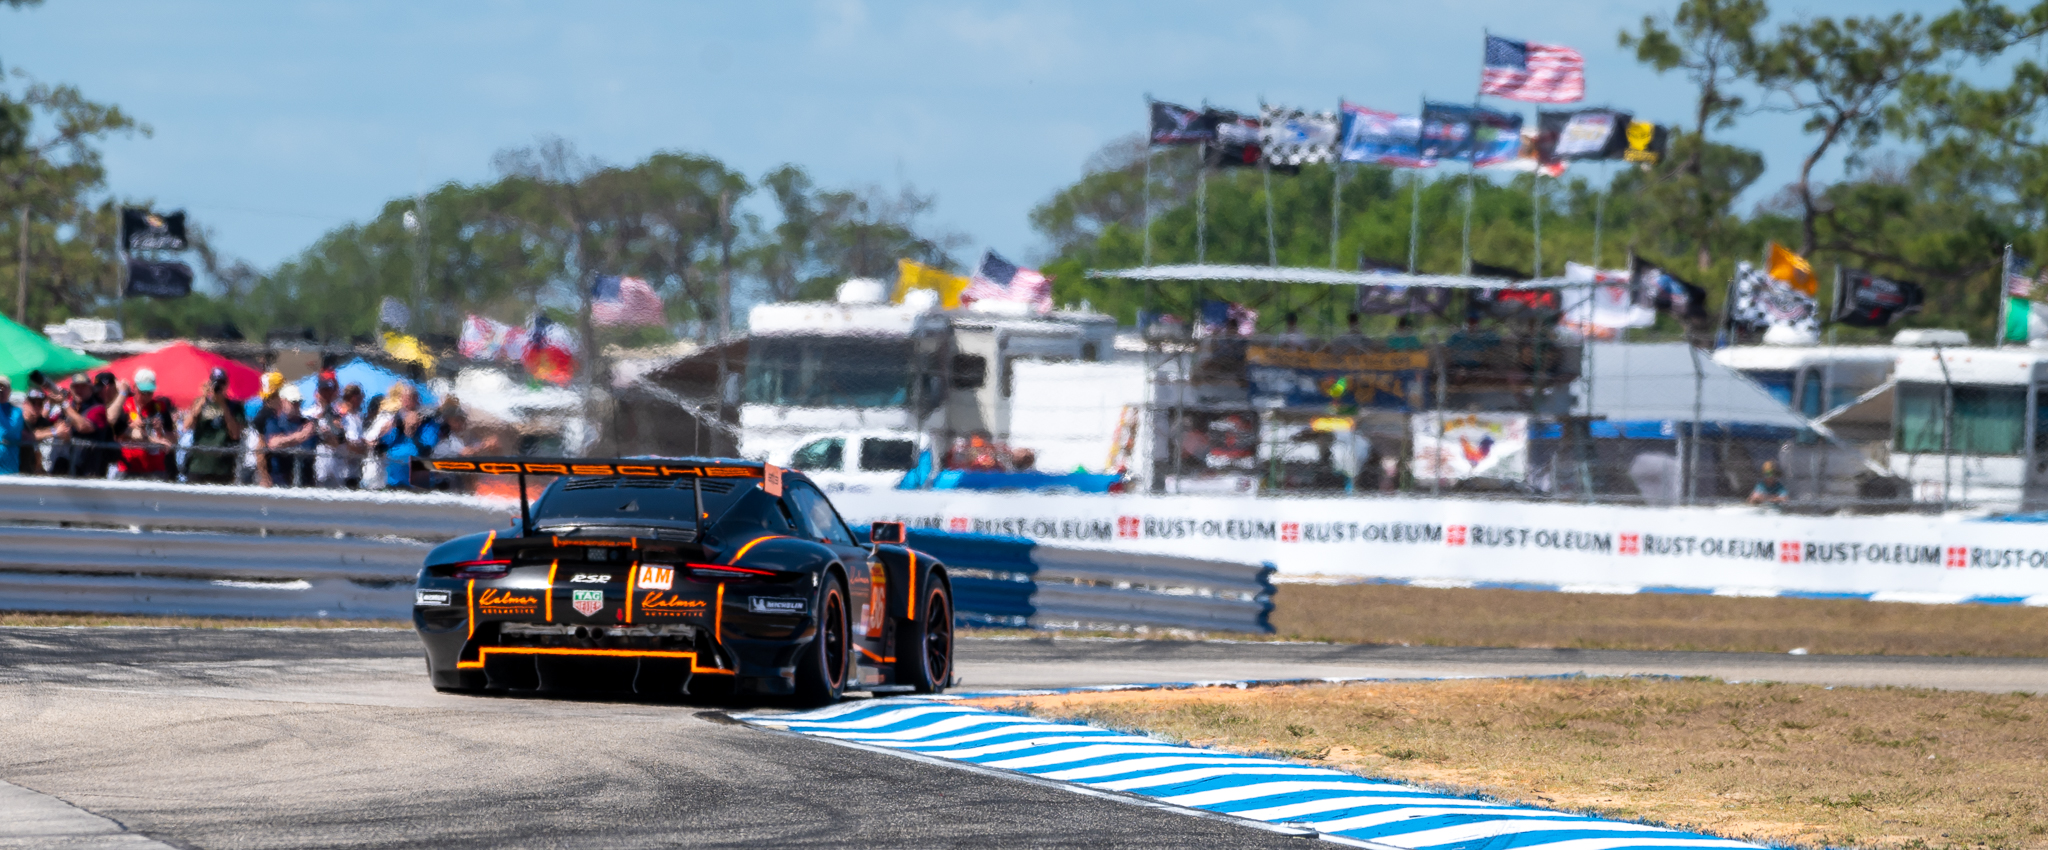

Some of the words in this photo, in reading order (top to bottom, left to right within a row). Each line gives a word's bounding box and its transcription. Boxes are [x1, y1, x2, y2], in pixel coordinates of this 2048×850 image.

[432, 461, 751, 477] PORSCHE
[570, 574, 612, 584] RSR
[642, 567, 671, 584] AM
[479, 588, 538, 606] Kalmar
[575, 592, 600, 600] TAG
[641, 591, 707, 608] Kalmar
[766, 601, 804, 609] MICHELIN
